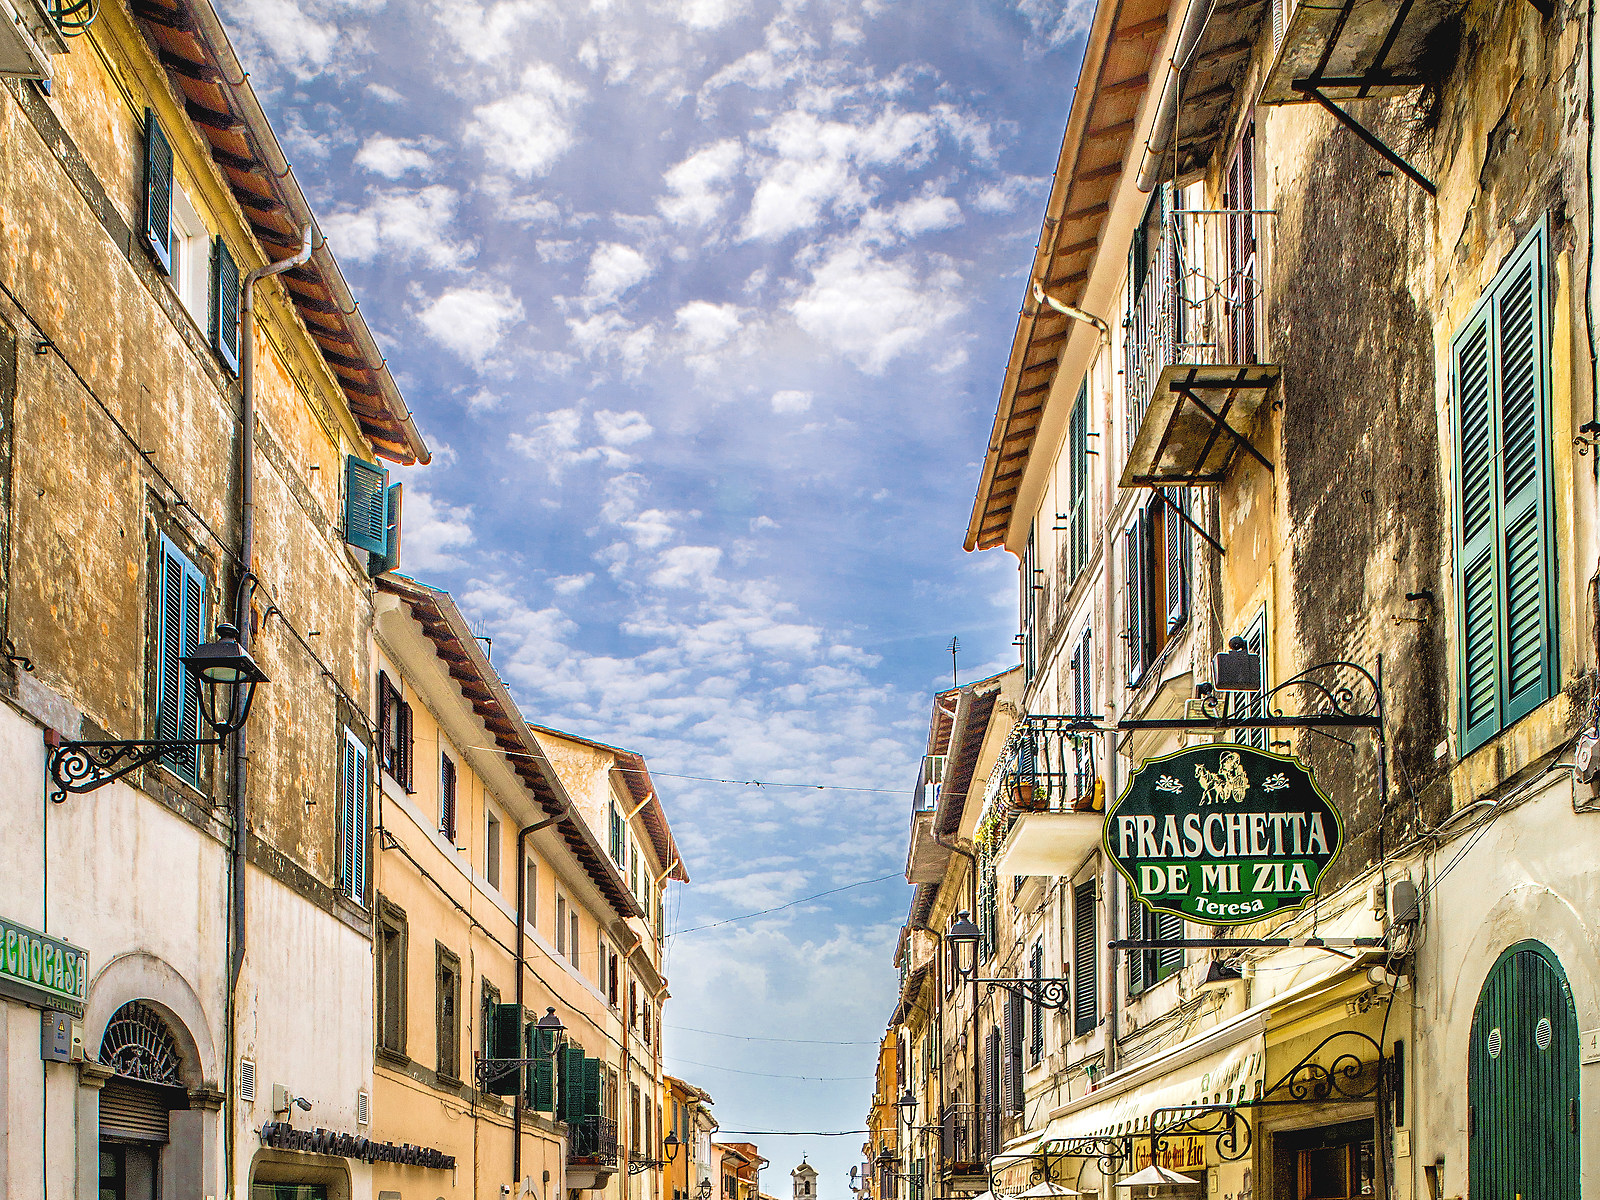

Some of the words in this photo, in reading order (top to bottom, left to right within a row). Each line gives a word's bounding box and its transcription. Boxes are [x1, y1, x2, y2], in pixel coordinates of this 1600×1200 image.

[1117, 812, 1330, 859] FRASCHETTA
[1140, 865, 1190, 895] DE
[1201, 864, 1241, 894] MI
[1251, 863, 1313, 893] ZIA
[1195, 896, 1265, 916] Teresa
[1590, 1034, 1597, 1049] 4
[1187, 1137, 1204, 1166] Zia
